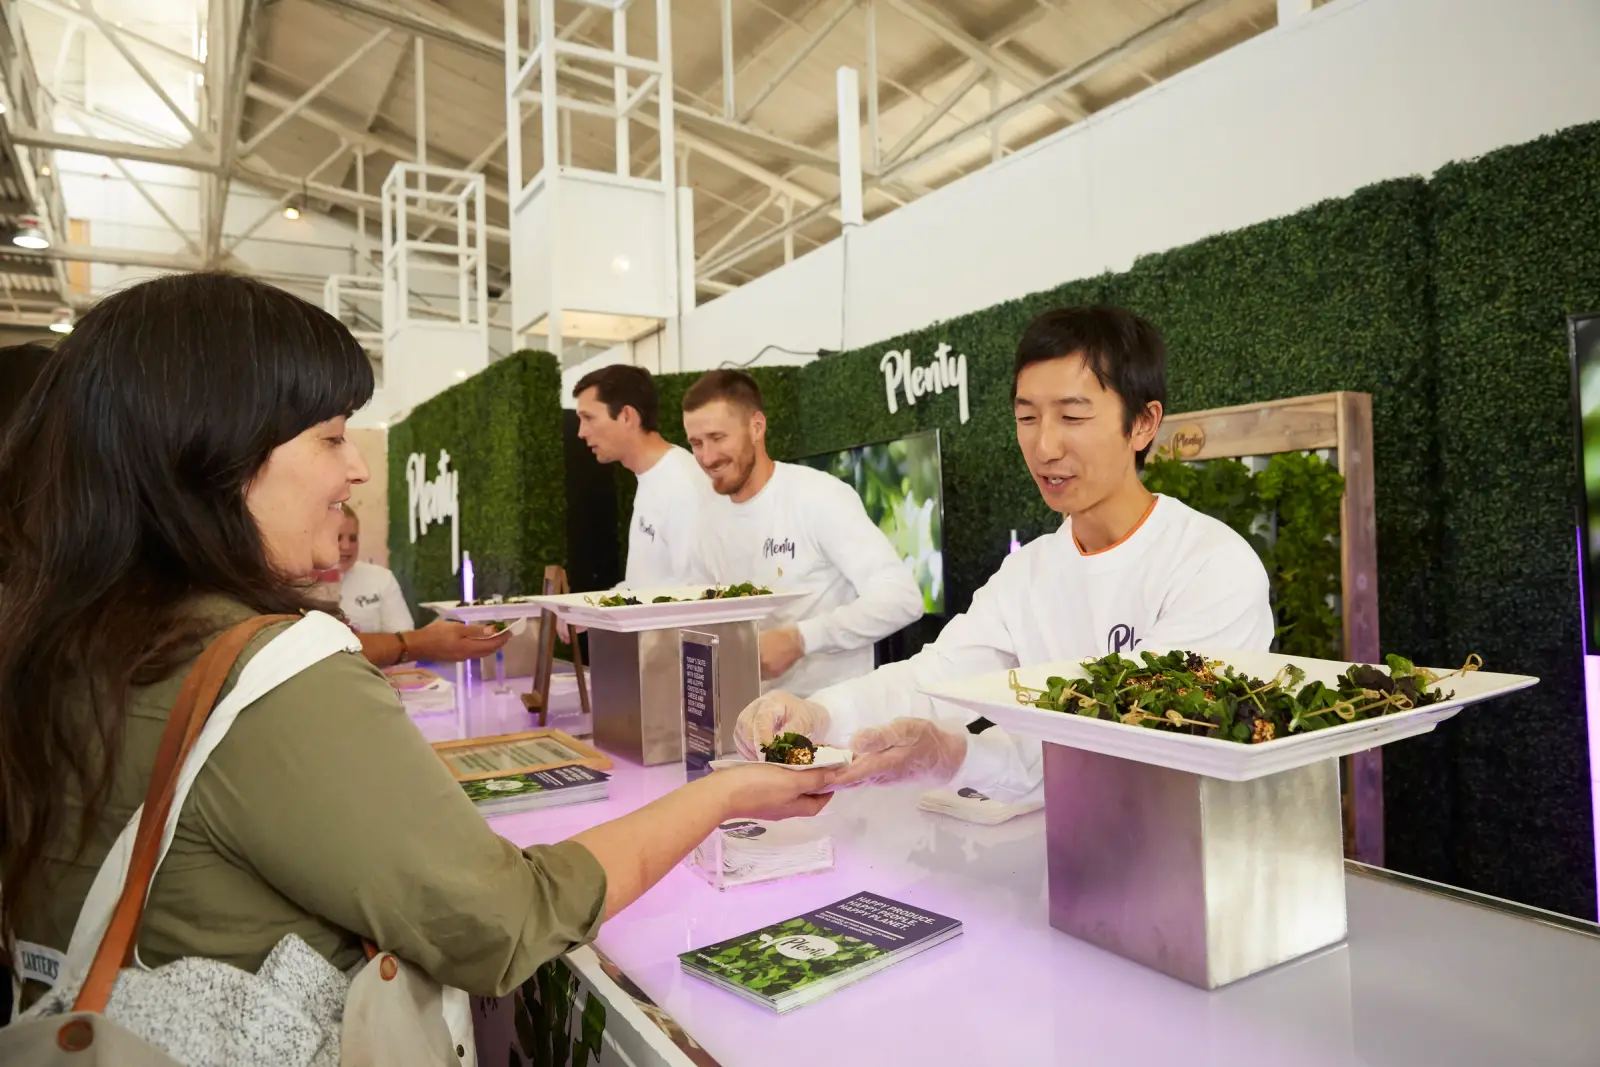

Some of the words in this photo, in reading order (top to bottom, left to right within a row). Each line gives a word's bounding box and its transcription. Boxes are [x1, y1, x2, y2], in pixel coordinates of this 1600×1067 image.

[880, 342, 970, 425] Plenty
[406, 448, 459, 576] Plenty
[763, 537, 795, 560] Plenty
[837, 904, 871, 917] HAPPY
[867, 914, 909, 931] PLANET.
[847, 900, 880, 913] HAPPY
[877, 909, 918, 927] PEOPLE.
[856, 896, 889, 909] HAPPY
[886, 905, 936, 925] PRODUCE.
[780, 937, 828, 958] Plenty
